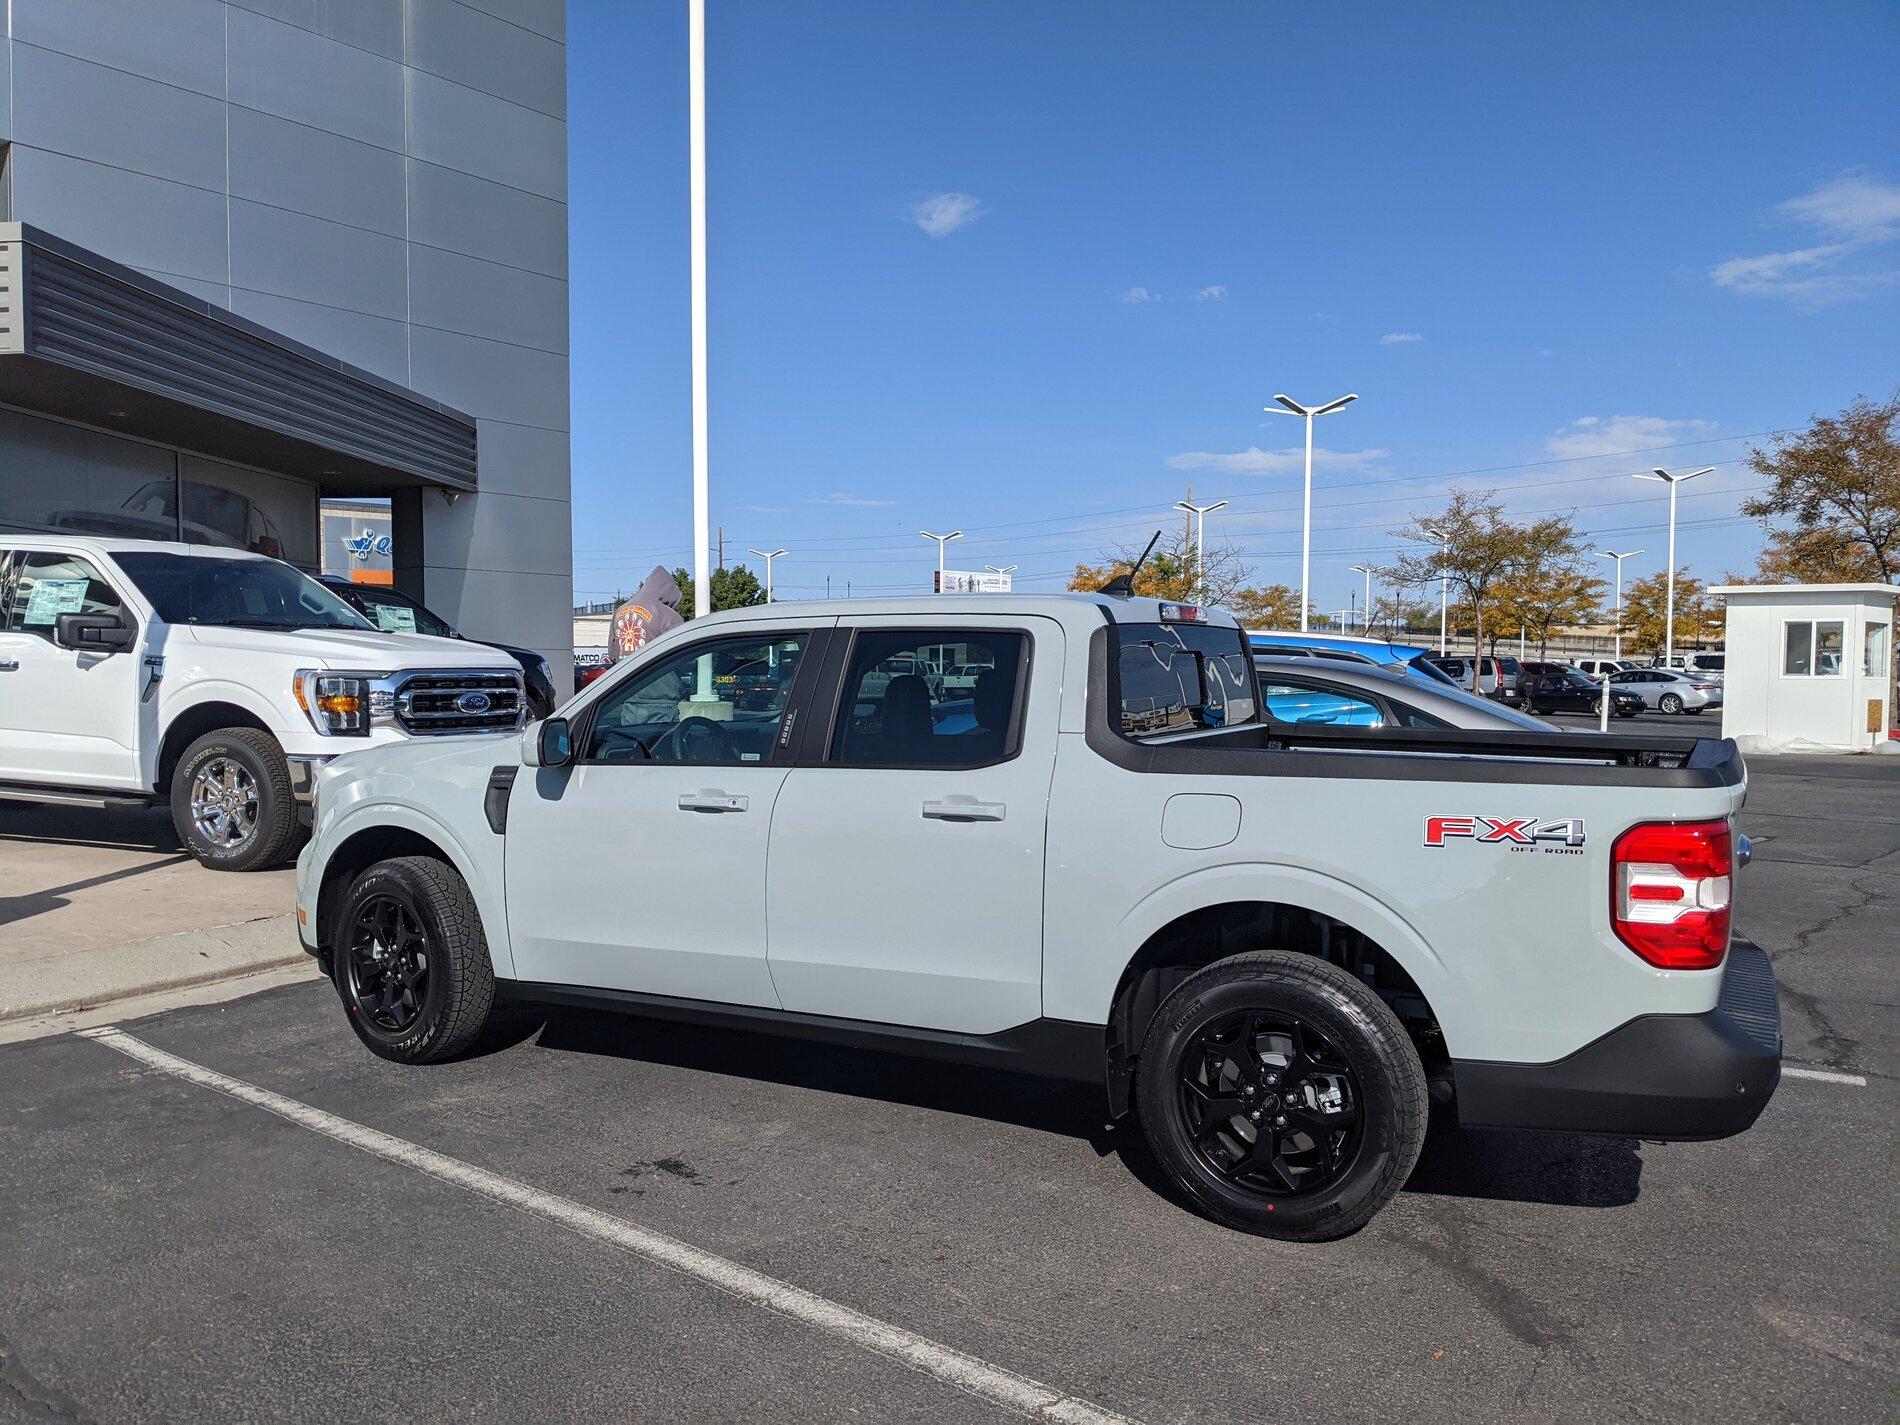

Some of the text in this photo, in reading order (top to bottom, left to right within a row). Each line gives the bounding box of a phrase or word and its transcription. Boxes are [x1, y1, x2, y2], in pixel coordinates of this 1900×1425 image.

[375, 536, 393, 556] Q
[573, 654, 600, 662] MATCO
[1423, 815, 1585, 848] FX4
[1545, 847, 1584, 856] ROAD
